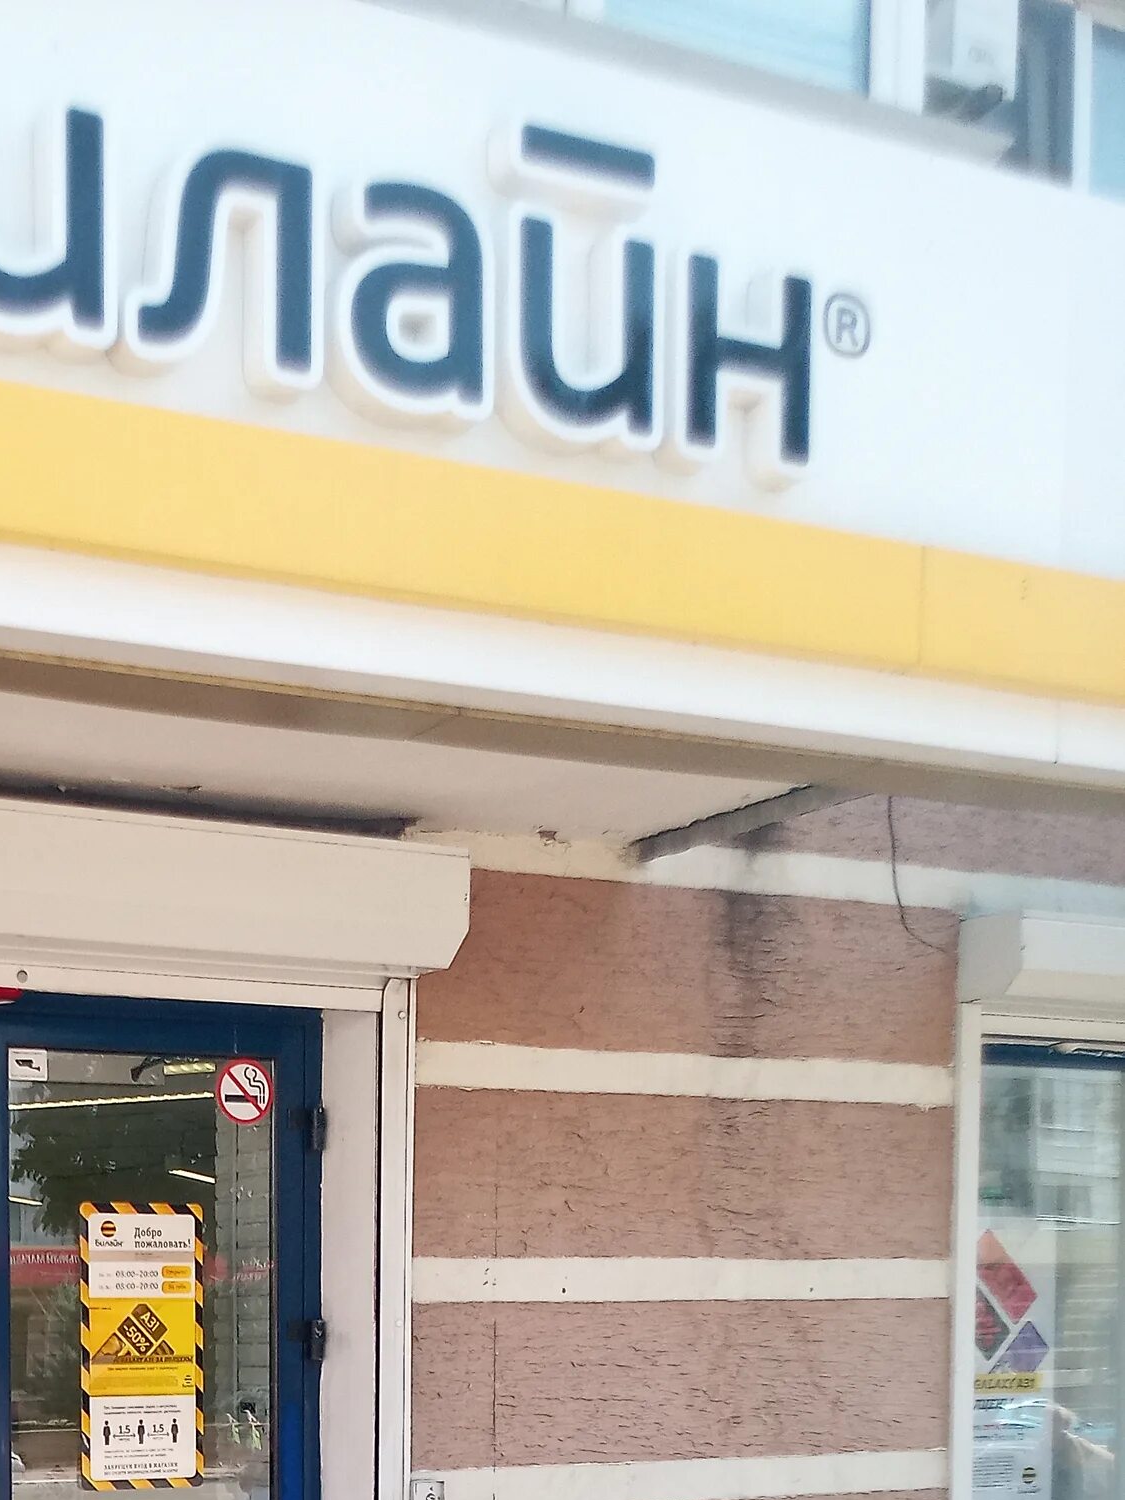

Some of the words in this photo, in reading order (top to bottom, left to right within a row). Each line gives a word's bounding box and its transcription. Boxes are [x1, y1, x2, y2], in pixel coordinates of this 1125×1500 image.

[133, 1227, 162, 1240] Добро
[134, 1238, 191, 1249] пожаловать!
[123, 1324, 150, 1353] -50%
